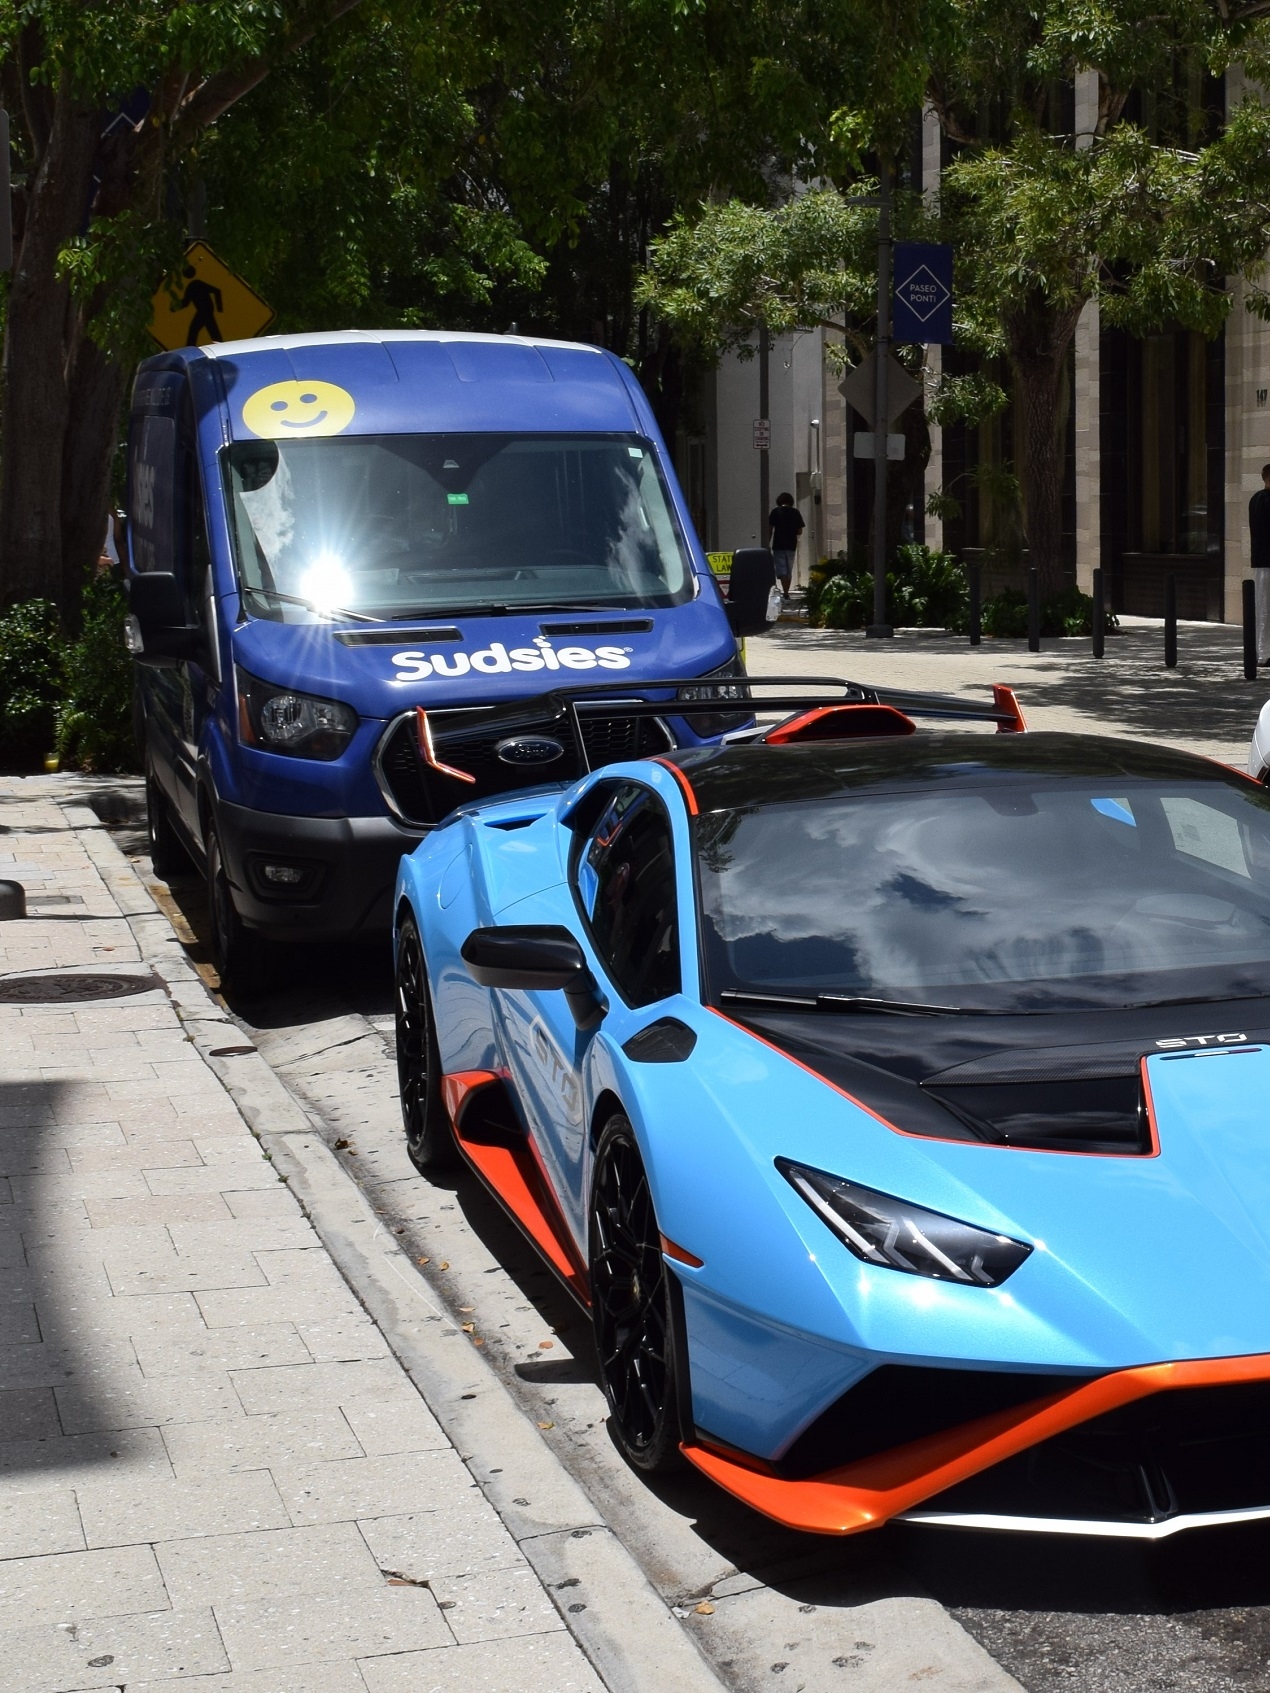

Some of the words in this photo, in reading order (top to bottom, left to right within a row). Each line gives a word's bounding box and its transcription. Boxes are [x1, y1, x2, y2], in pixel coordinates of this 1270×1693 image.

[910, 283, 937, 293] PASEO
[910, 294, 937, 303] PONTI
[712, 555, 733, 563] STAT
[391, 636, 631, 681] Sudsies
[1155, 1033, 1248, 1048] STO
